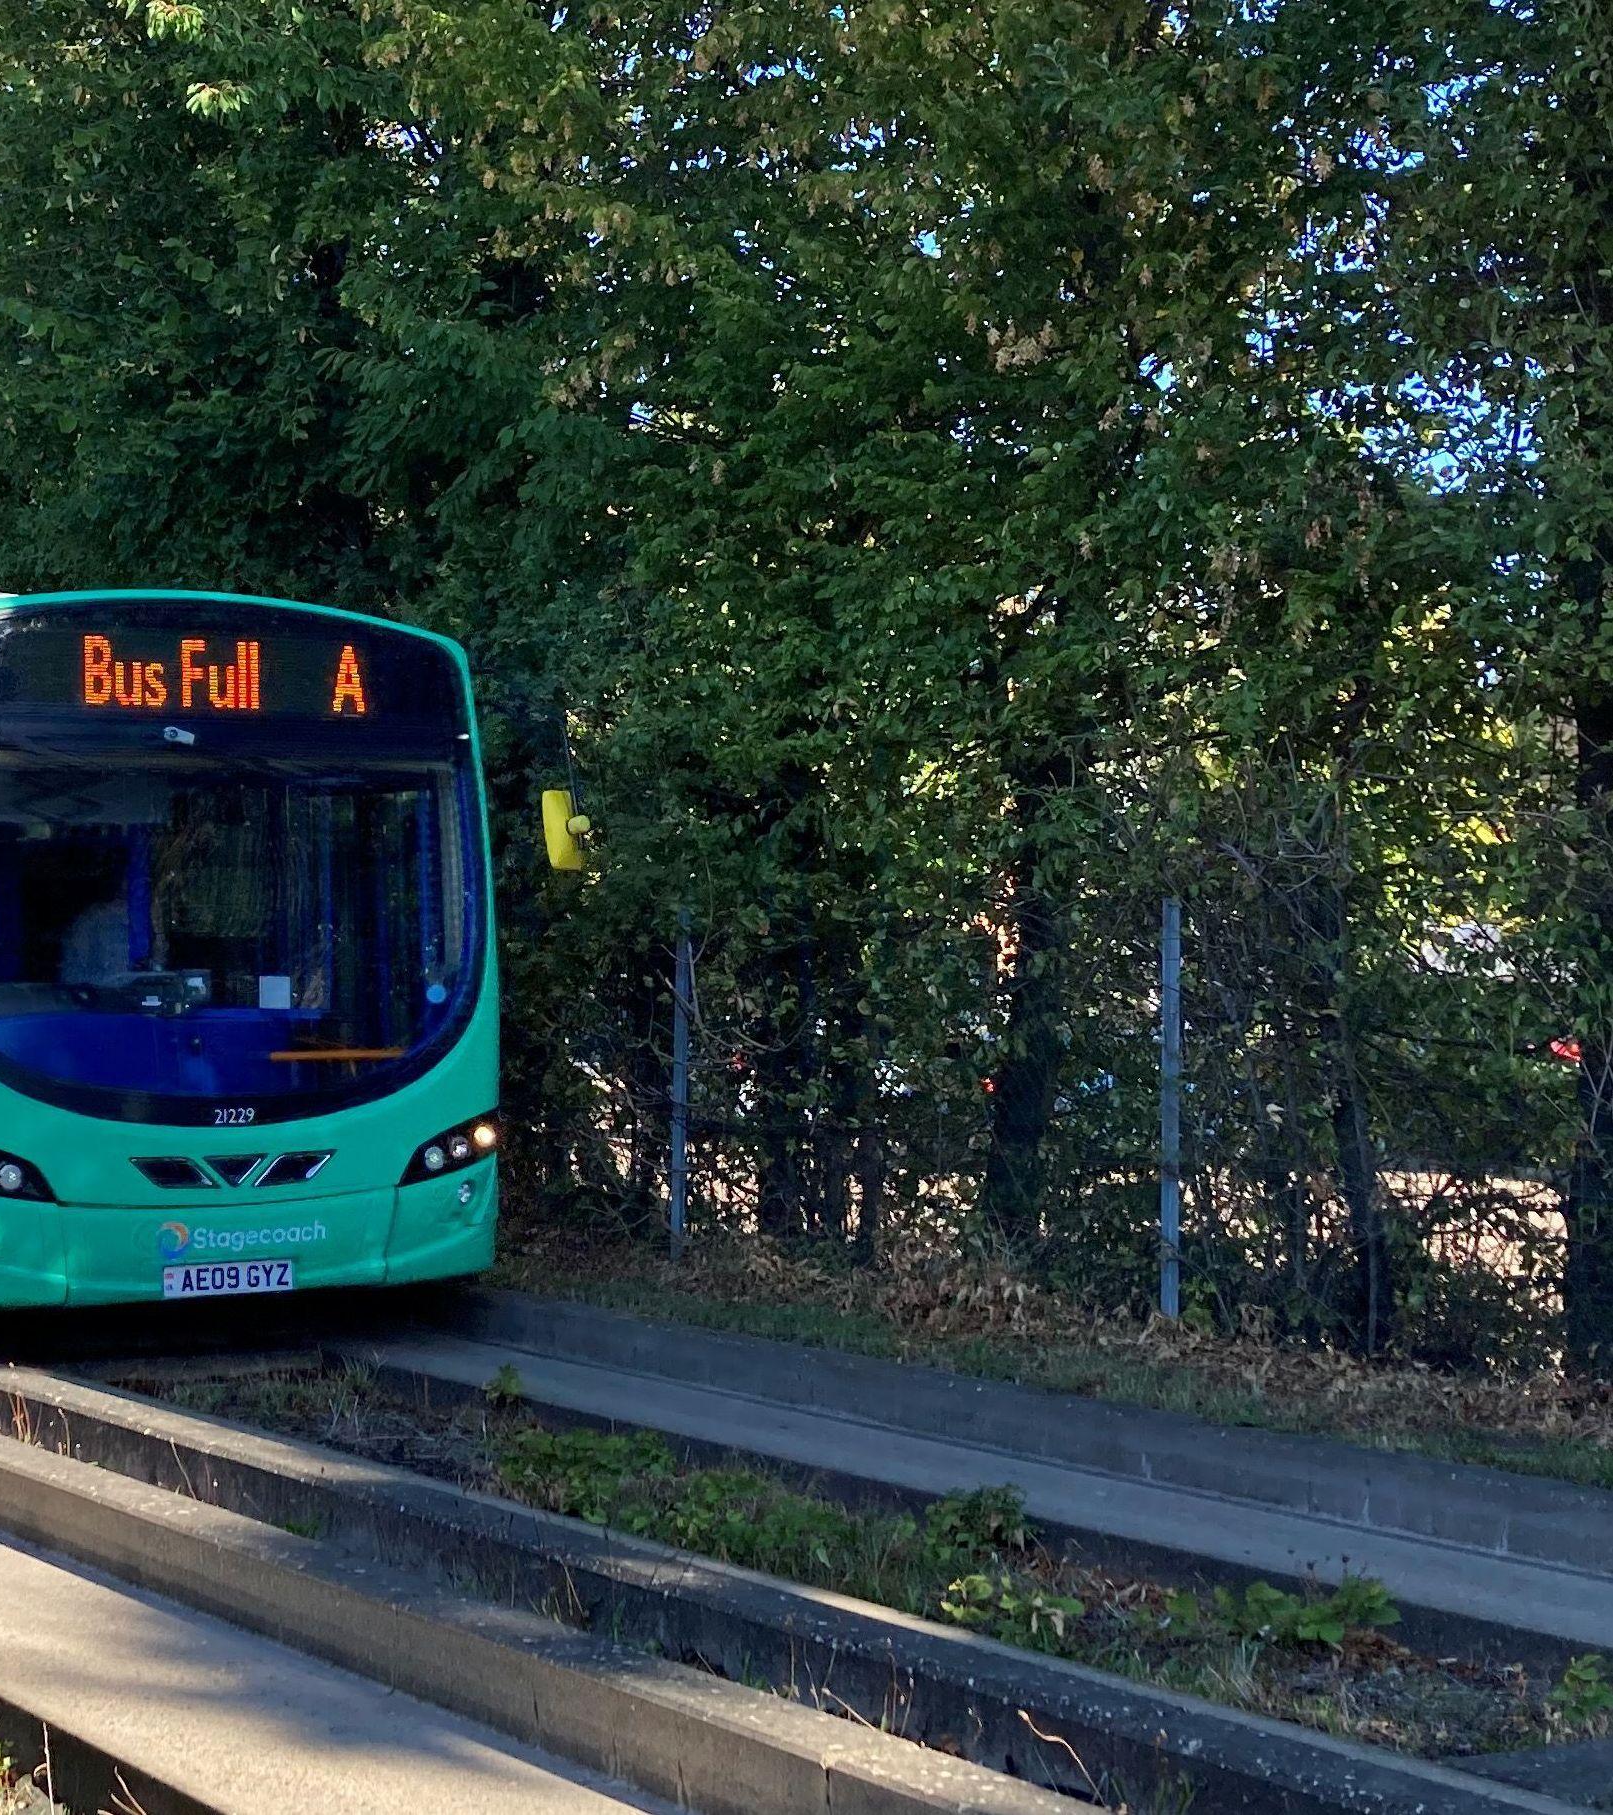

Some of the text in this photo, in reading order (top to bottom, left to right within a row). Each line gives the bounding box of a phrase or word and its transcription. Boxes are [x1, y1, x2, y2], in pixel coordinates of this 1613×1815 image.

[83, 635, 260, 709] Bus Full
[331, 645, 366, 713] A
[214, 1107, 256, 1125] 21229
[193, 1218, 326, 1251] Stagecoach
[181, 1263, 290, 1292] AE09 GYZ
